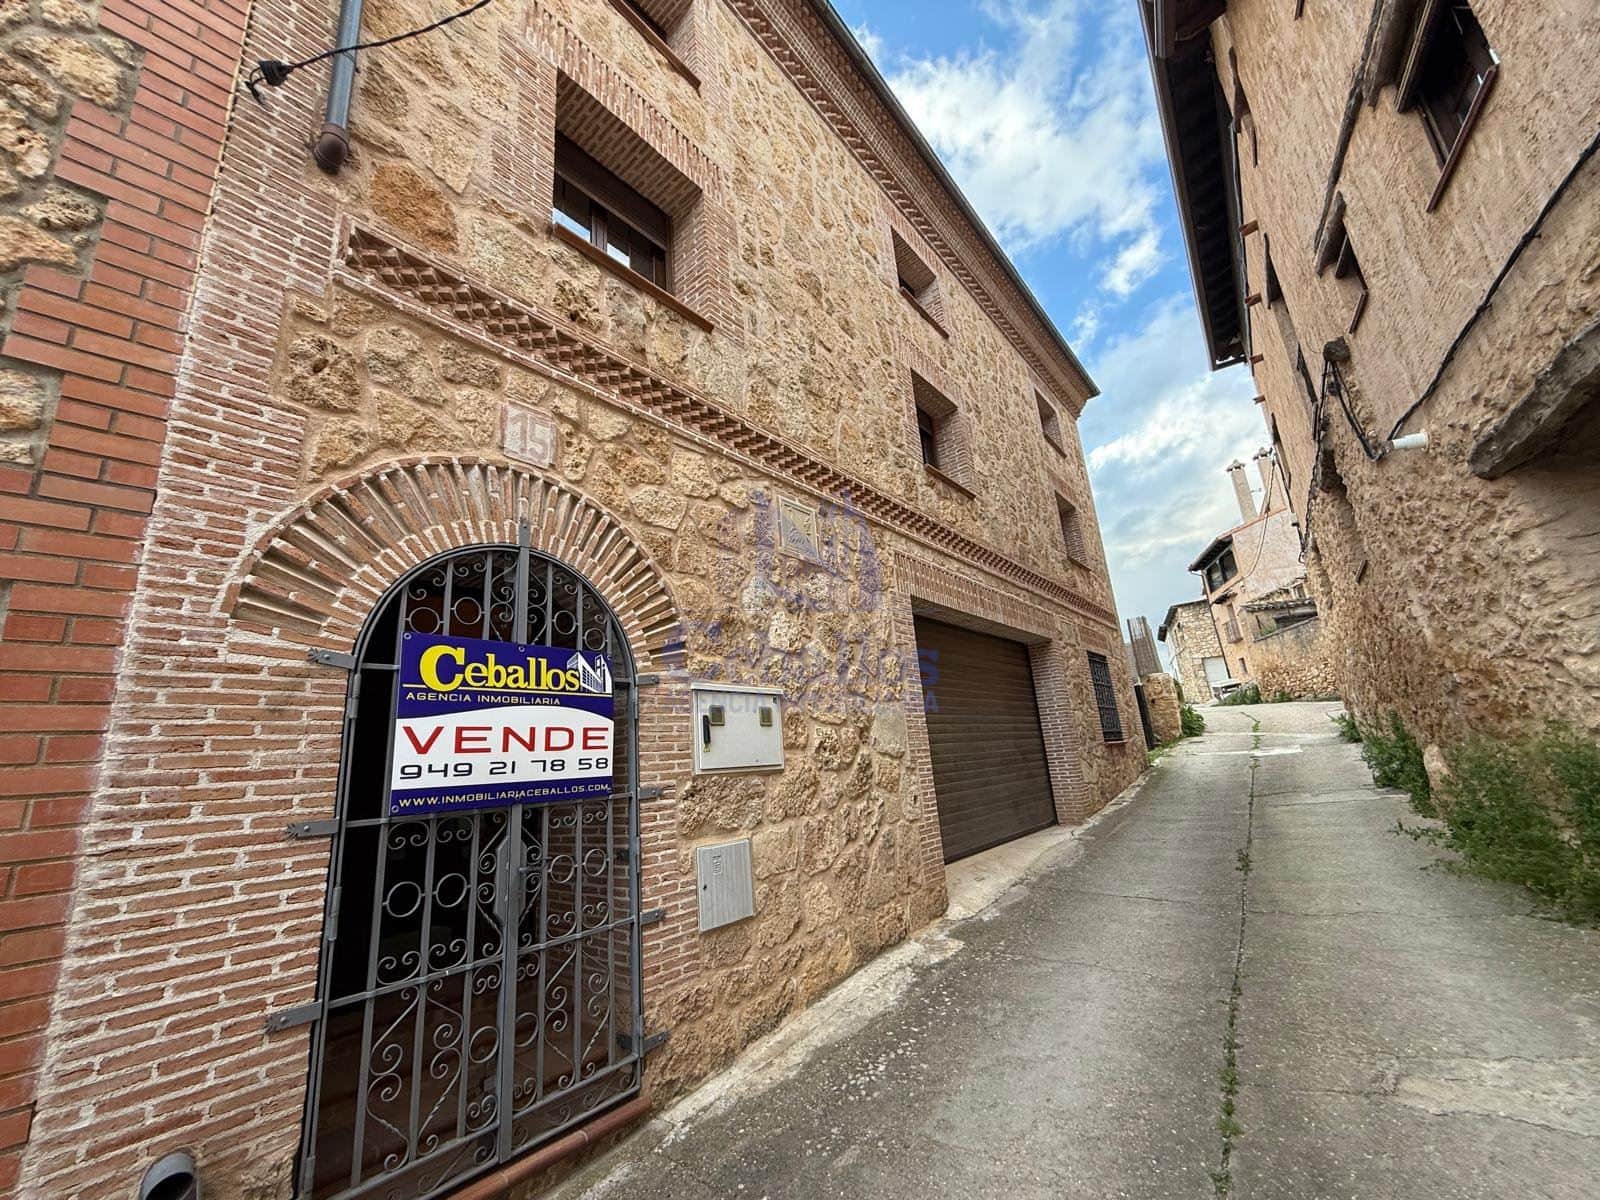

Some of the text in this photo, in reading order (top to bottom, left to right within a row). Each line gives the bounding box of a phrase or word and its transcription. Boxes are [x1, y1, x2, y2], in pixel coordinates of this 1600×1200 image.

[508, 412, 549, 460] 15
[419, 645, 581, 691] Ceballos
[405, 692, 560, 705] AGENCIA INMOBILIARIA
[402, 726, 609, 755] VENDE
[399, 757, 609, 780] 949 21 78 58
[399, 784, 609, 807] WWW.INMOBILIARIACEBALLOS.COM
